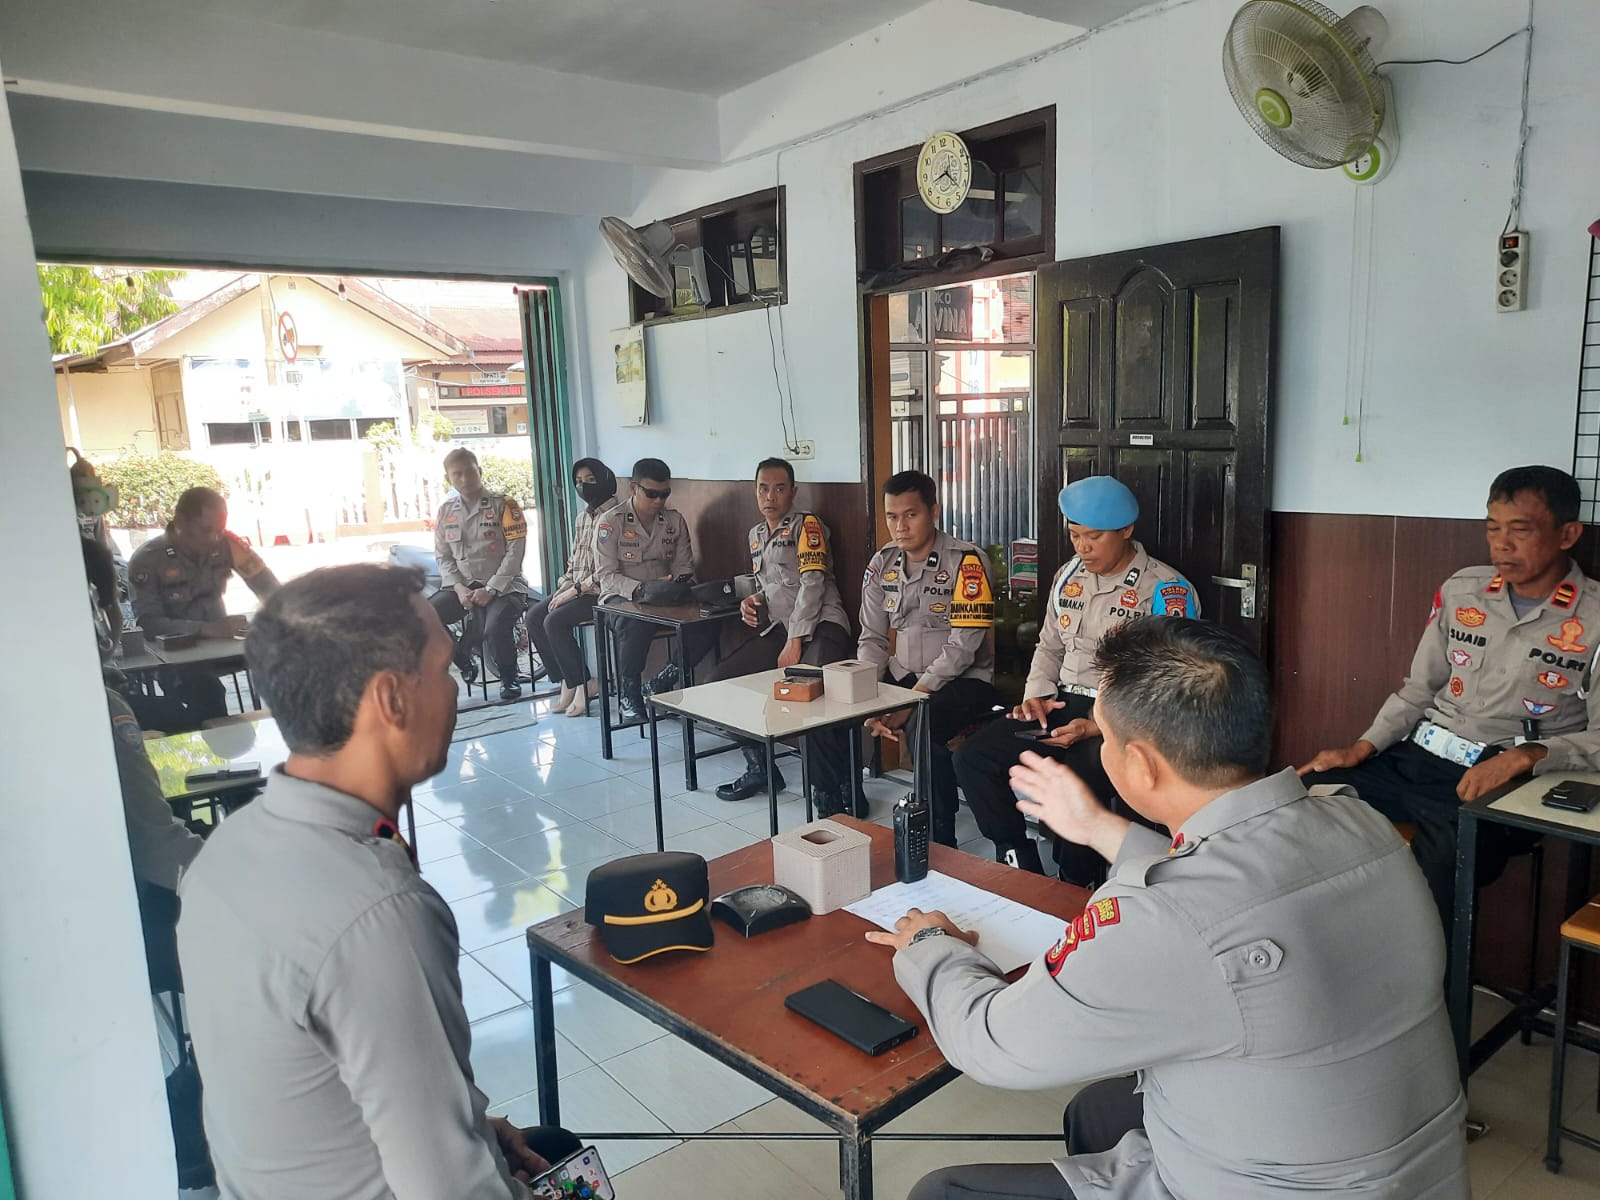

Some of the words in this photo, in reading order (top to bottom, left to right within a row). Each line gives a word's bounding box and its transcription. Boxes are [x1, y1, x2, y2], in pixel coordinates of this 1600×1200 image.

[939, 138, 947, 148] 12
[952, 139, 956, 148] 1
[931, 145, 937, 154] 11
[925, 157, 932, 167] 10
[923, 173, 928, 182] 9
[928, 187, 933, 196] 8
[936, 196, 941, 205] 7
[955, 192, 961, 201] 5
[946, 198, 951, 207] 6
[923, 586, 954, 596] POLRI
[1450, 628, 1487, 647] SUAIB
[1529, 648, 1586, 672] POLRI
